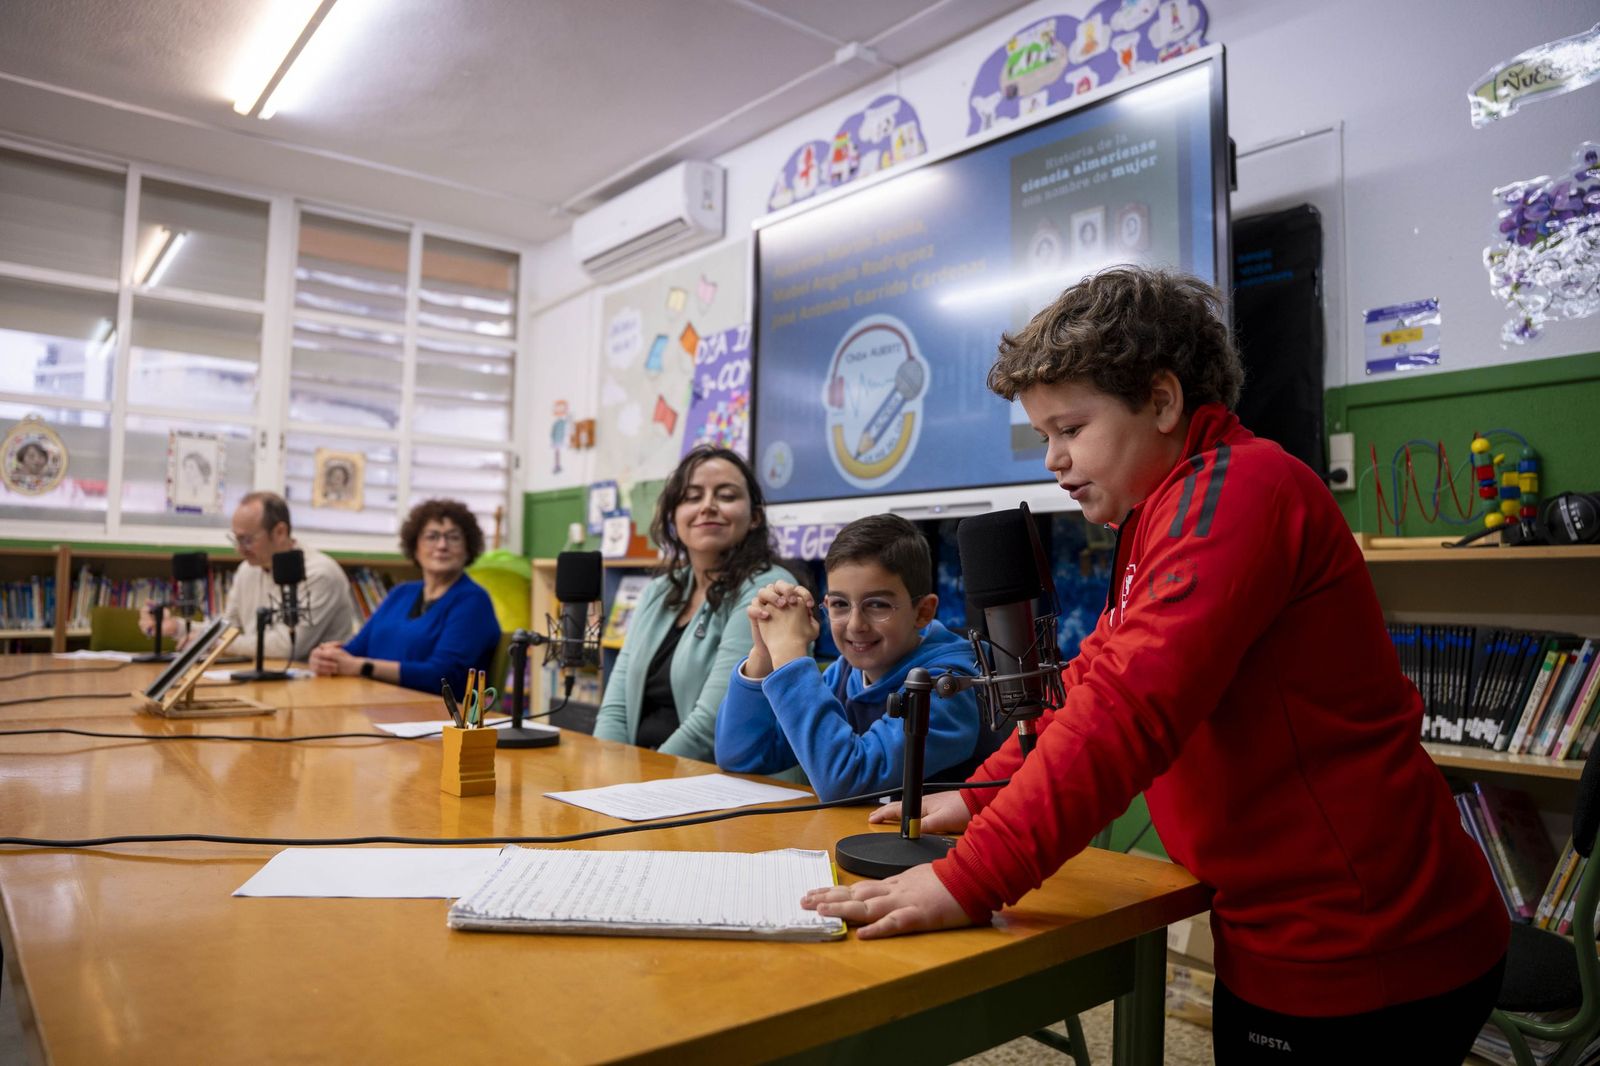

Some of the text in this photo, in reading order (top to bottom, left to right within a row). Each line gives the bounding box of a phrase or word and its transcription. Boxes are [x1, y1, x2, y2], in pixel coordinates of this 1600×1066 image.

[1021, 139, 1157, 194] ciencia almeriense
[1045, 133, 1128, 170] Historia de la
[1044, 176, 1090, 200] nombre
[1093, 170, 1109, 184] de
[1112, 155, 1158, 179] mujer
[854, 280, 908, 306] Garrido
[1249, 1031, 1292, 1052] KIPSTA
